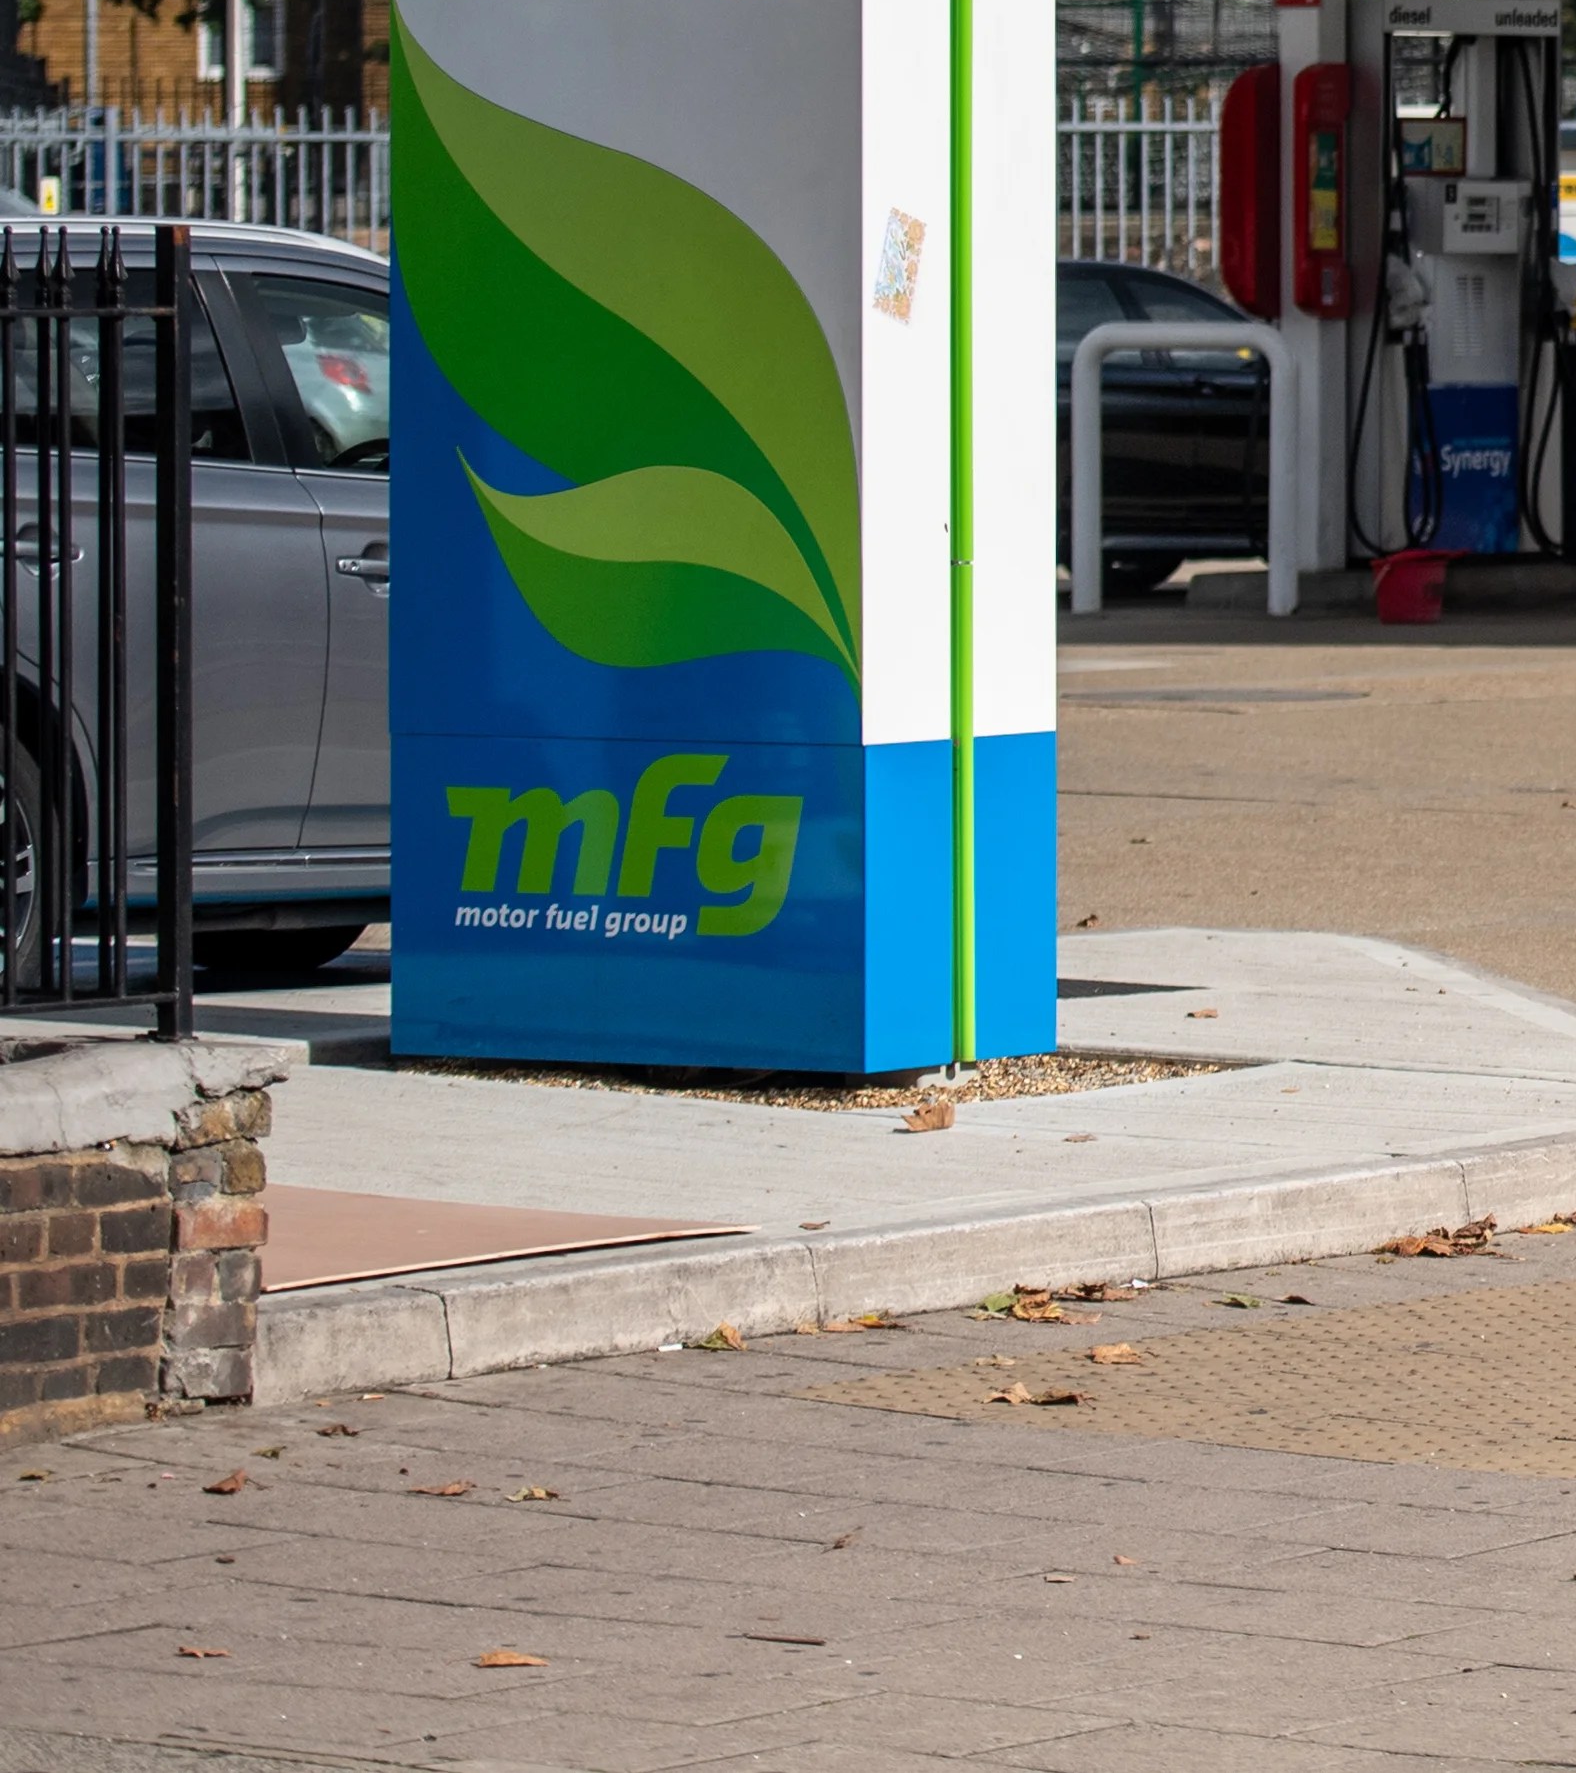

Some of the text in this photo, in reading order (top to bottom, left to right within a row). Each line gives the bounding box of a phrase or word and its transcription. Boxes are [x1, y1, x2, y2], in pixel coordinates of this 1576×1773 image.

[1388, 6, 1431, 25] diesel
[1494, 8, 1558, 26] unleaded
[1440, 445, 1512, 476] Synergy
[445, 753, 804, 937] mfg
[455, 903, 688, 940] motor fuel group
